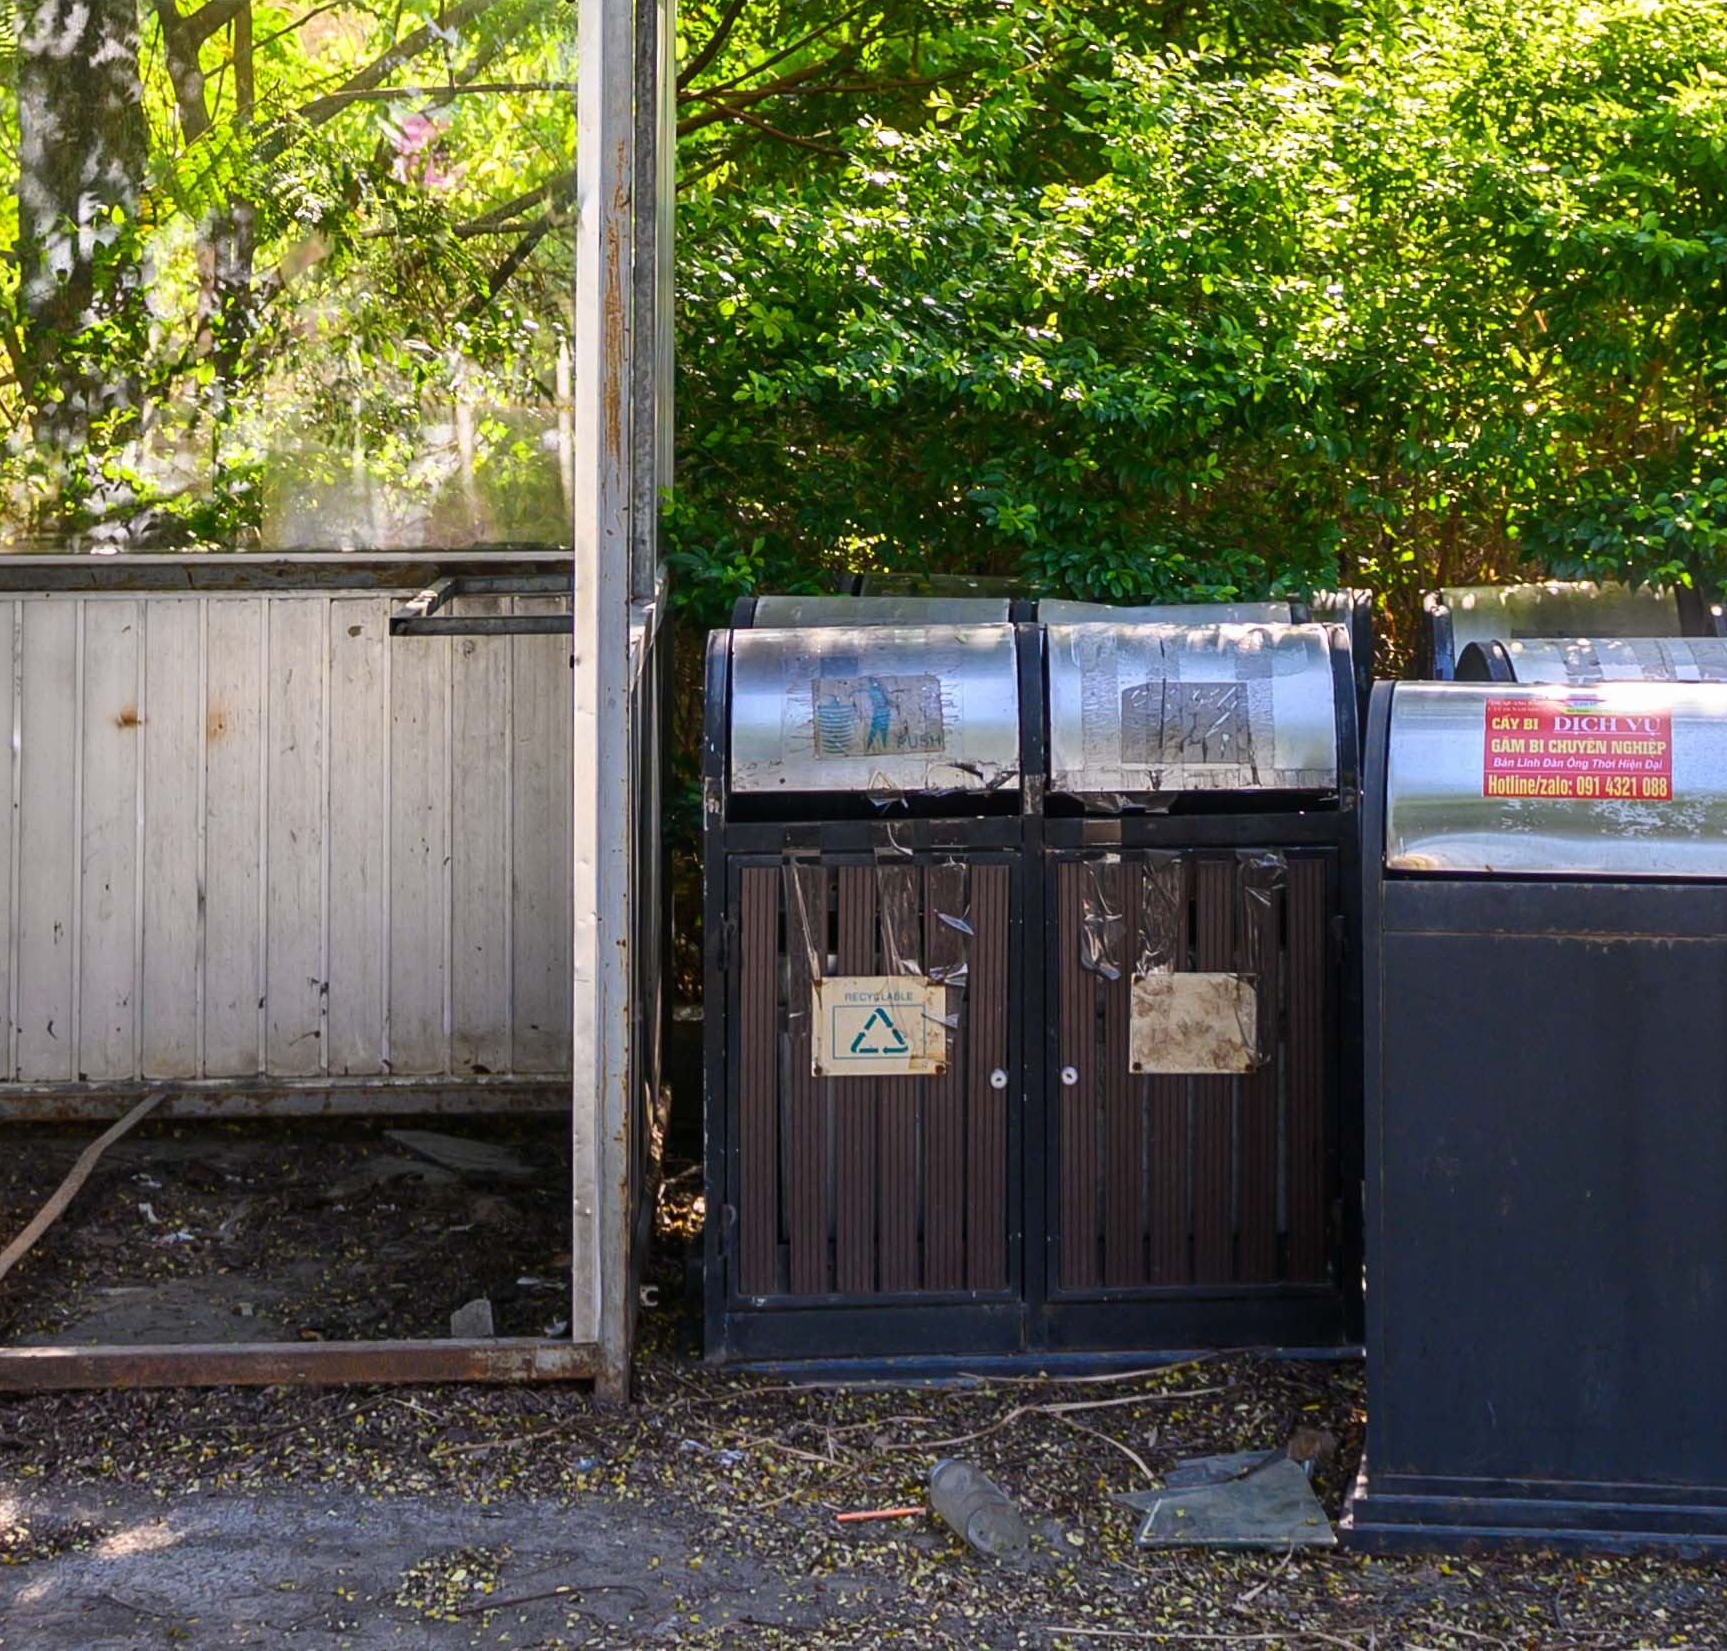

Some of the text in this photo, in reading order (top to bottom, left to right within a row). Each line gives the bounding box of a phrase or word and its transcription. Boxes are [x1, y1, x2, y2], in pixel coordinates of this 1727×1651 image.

[1523, 717, 1539, 730] BI
[1553, 716, 1661, 736] DỊCH VỤ
[1529, 739, 1545, 753] BI
[1548, 737, 1607, 754] CHUYÊN
[1611, 738, 1666, 758] NGHIỆP
[1488, 774, 1668, 797] Hotline/zalo: 091 4321 088
